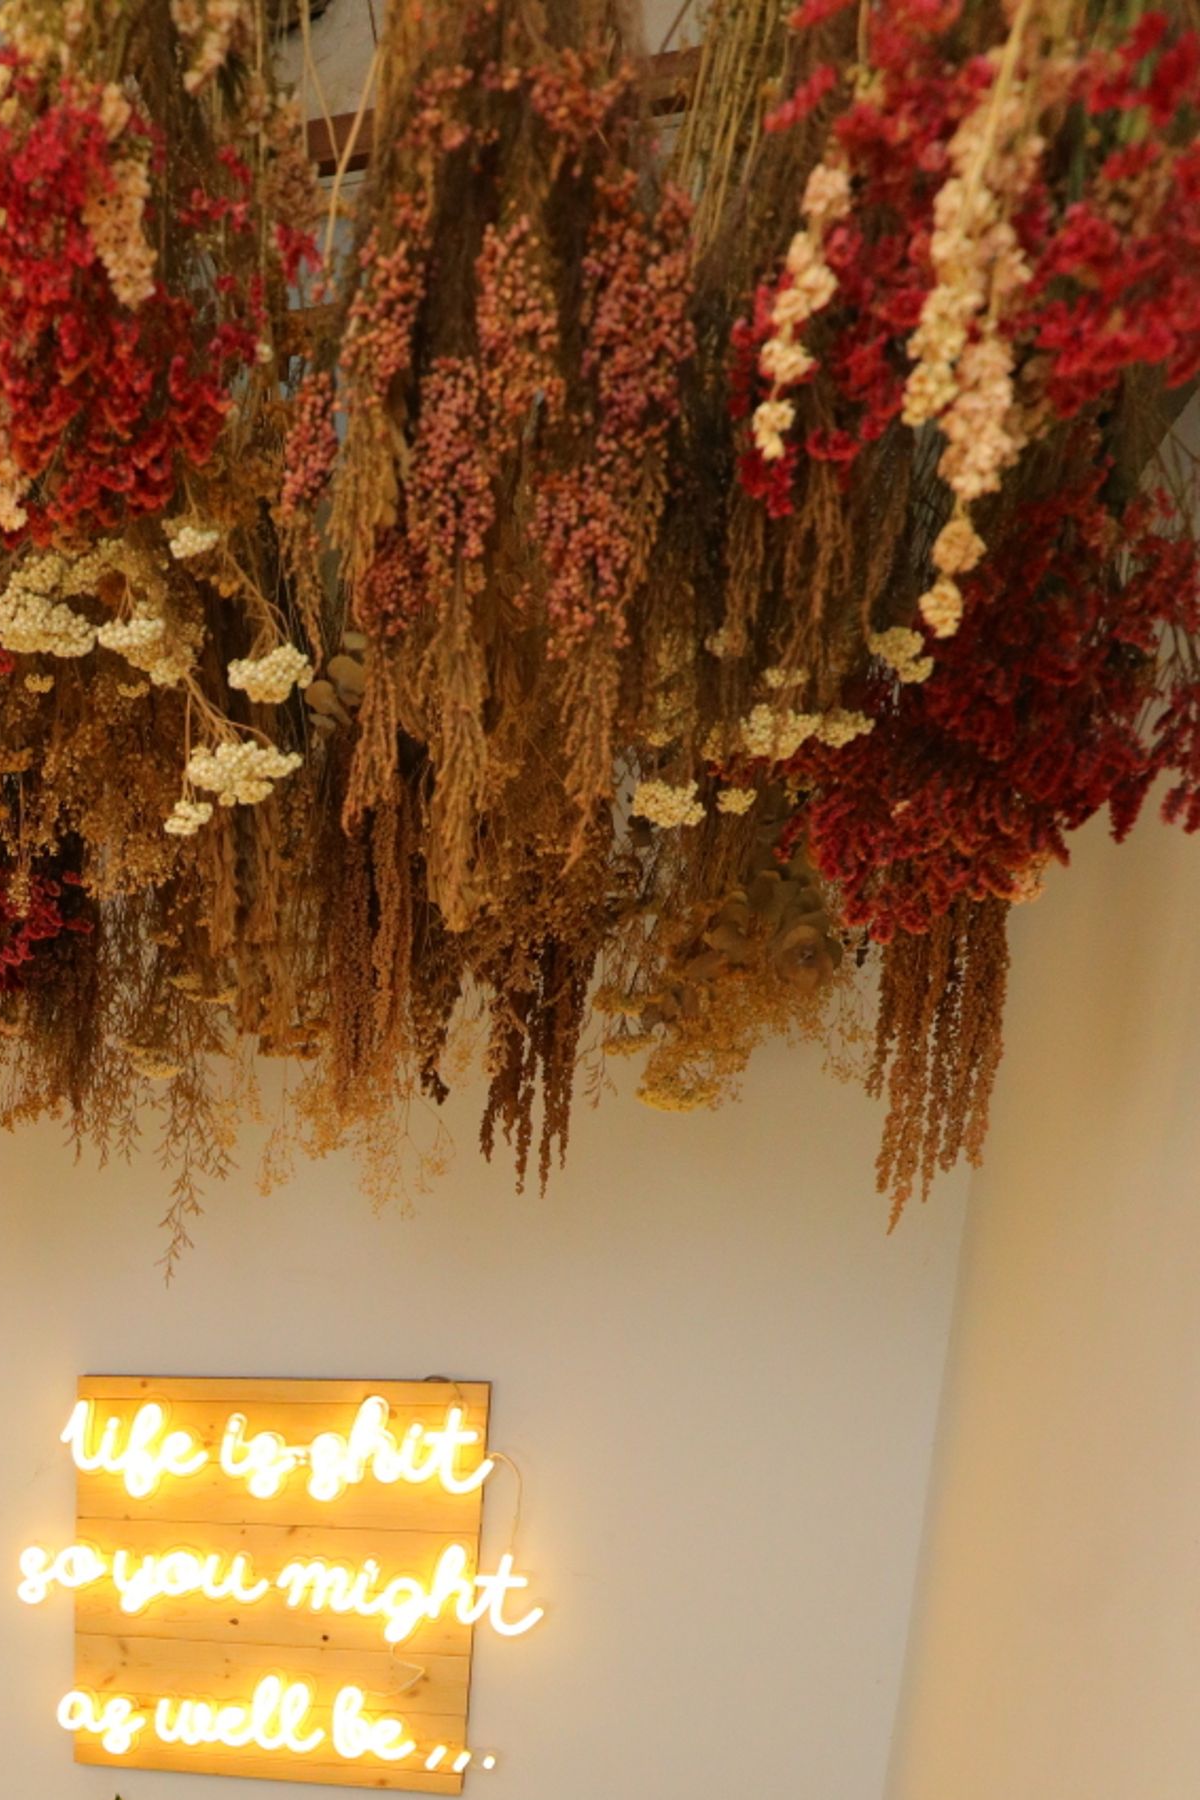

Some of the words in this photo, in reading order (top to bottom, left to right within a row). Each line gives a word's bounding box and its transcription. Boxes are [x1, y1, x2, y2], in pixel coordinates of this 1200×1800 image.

[61, 1399, 209, 1498] life
[220, 1413, 304, 1498] is
[308, 1396, 495, 1501] shit
[17, 1545, 107, 1604] so
[113, 1550, 269, 1613] you
[277, 1544, 545, 1643] might
[57, 1691, 145, 1755] as
[154, 1674, 324, 1753] well
